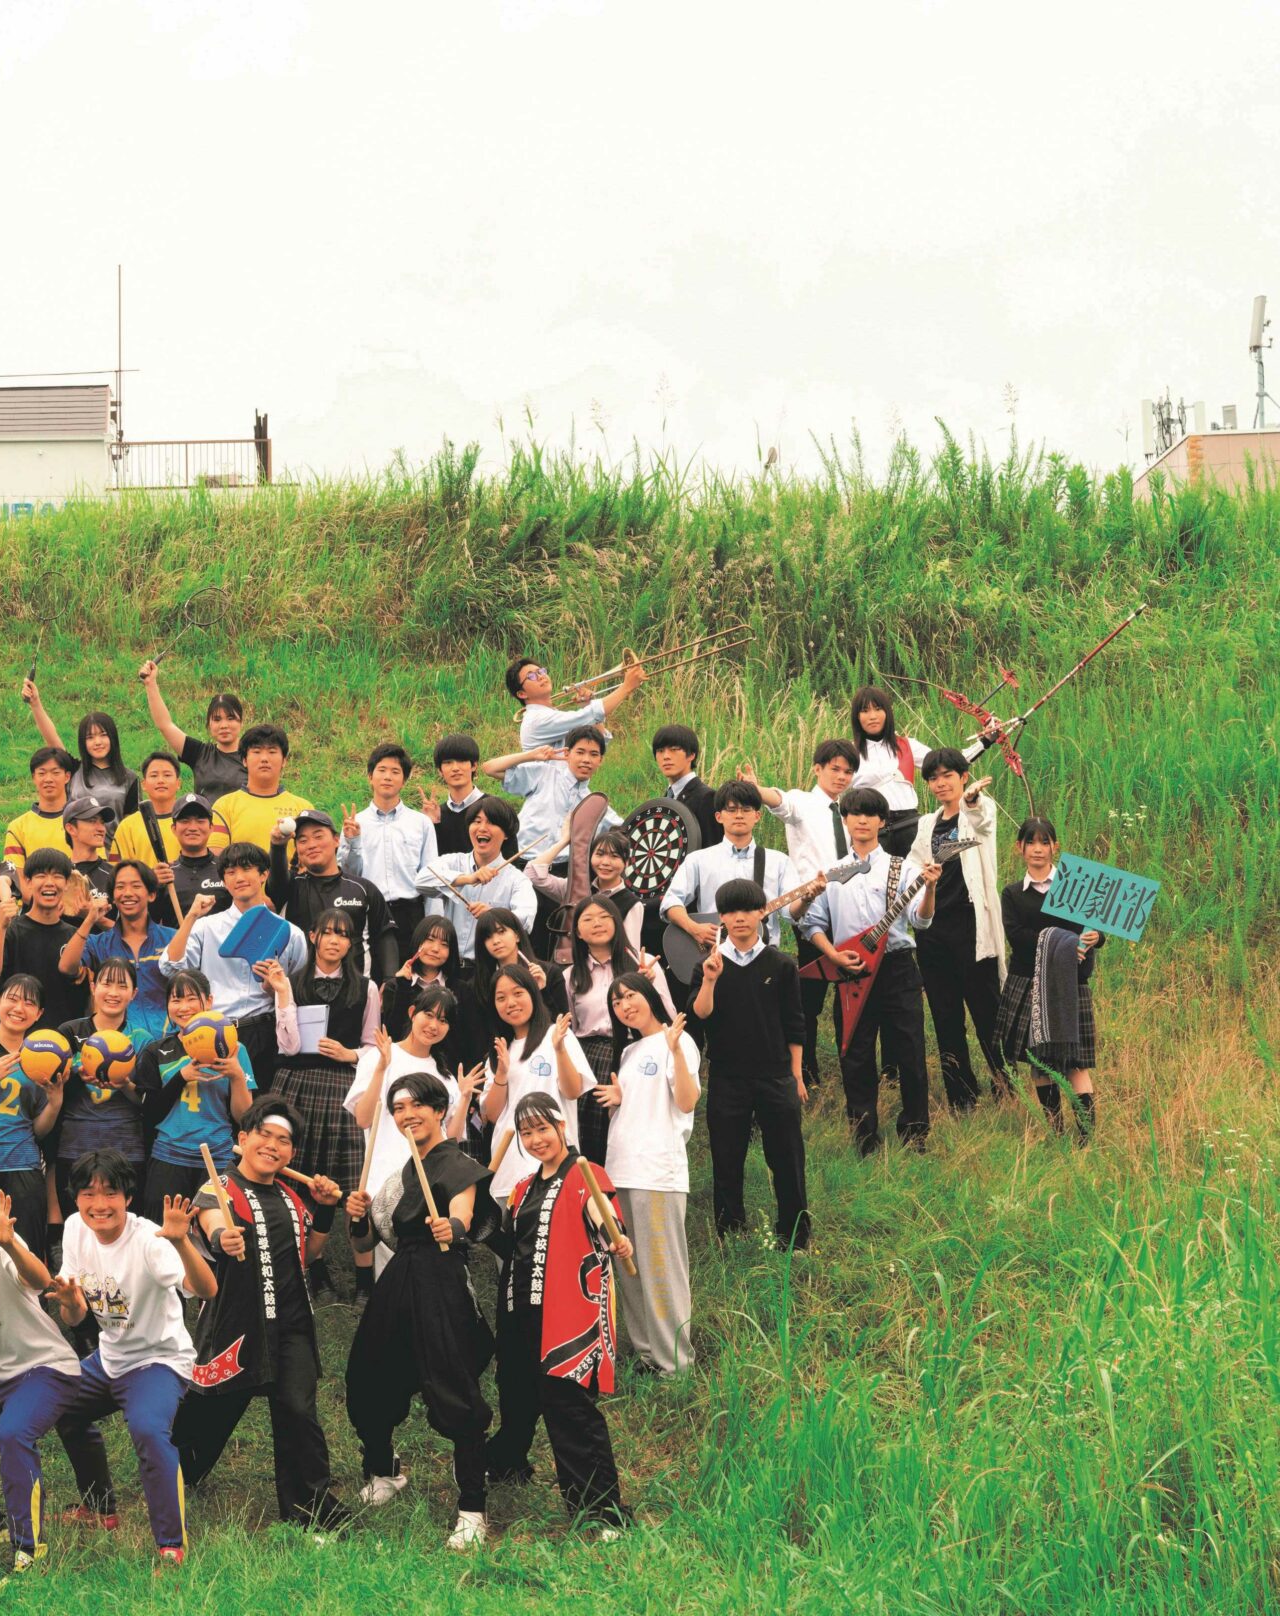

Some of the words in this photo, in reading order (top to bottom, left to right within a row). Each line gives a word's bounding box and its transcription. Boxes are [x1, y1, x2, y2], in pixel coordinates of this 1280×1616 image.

[200, 878, 226, 889] Osak
[333, 896, 363, 907] Osaka
[1049, 860, 1158, 932] 演劇部
[180, 1080, 202, 1113] 4
[244, 1187, 277, 1320] 大阪高等学校和太鼓部
[530, 1177, 563, 1306] 大阪高等学校和太鼓部
